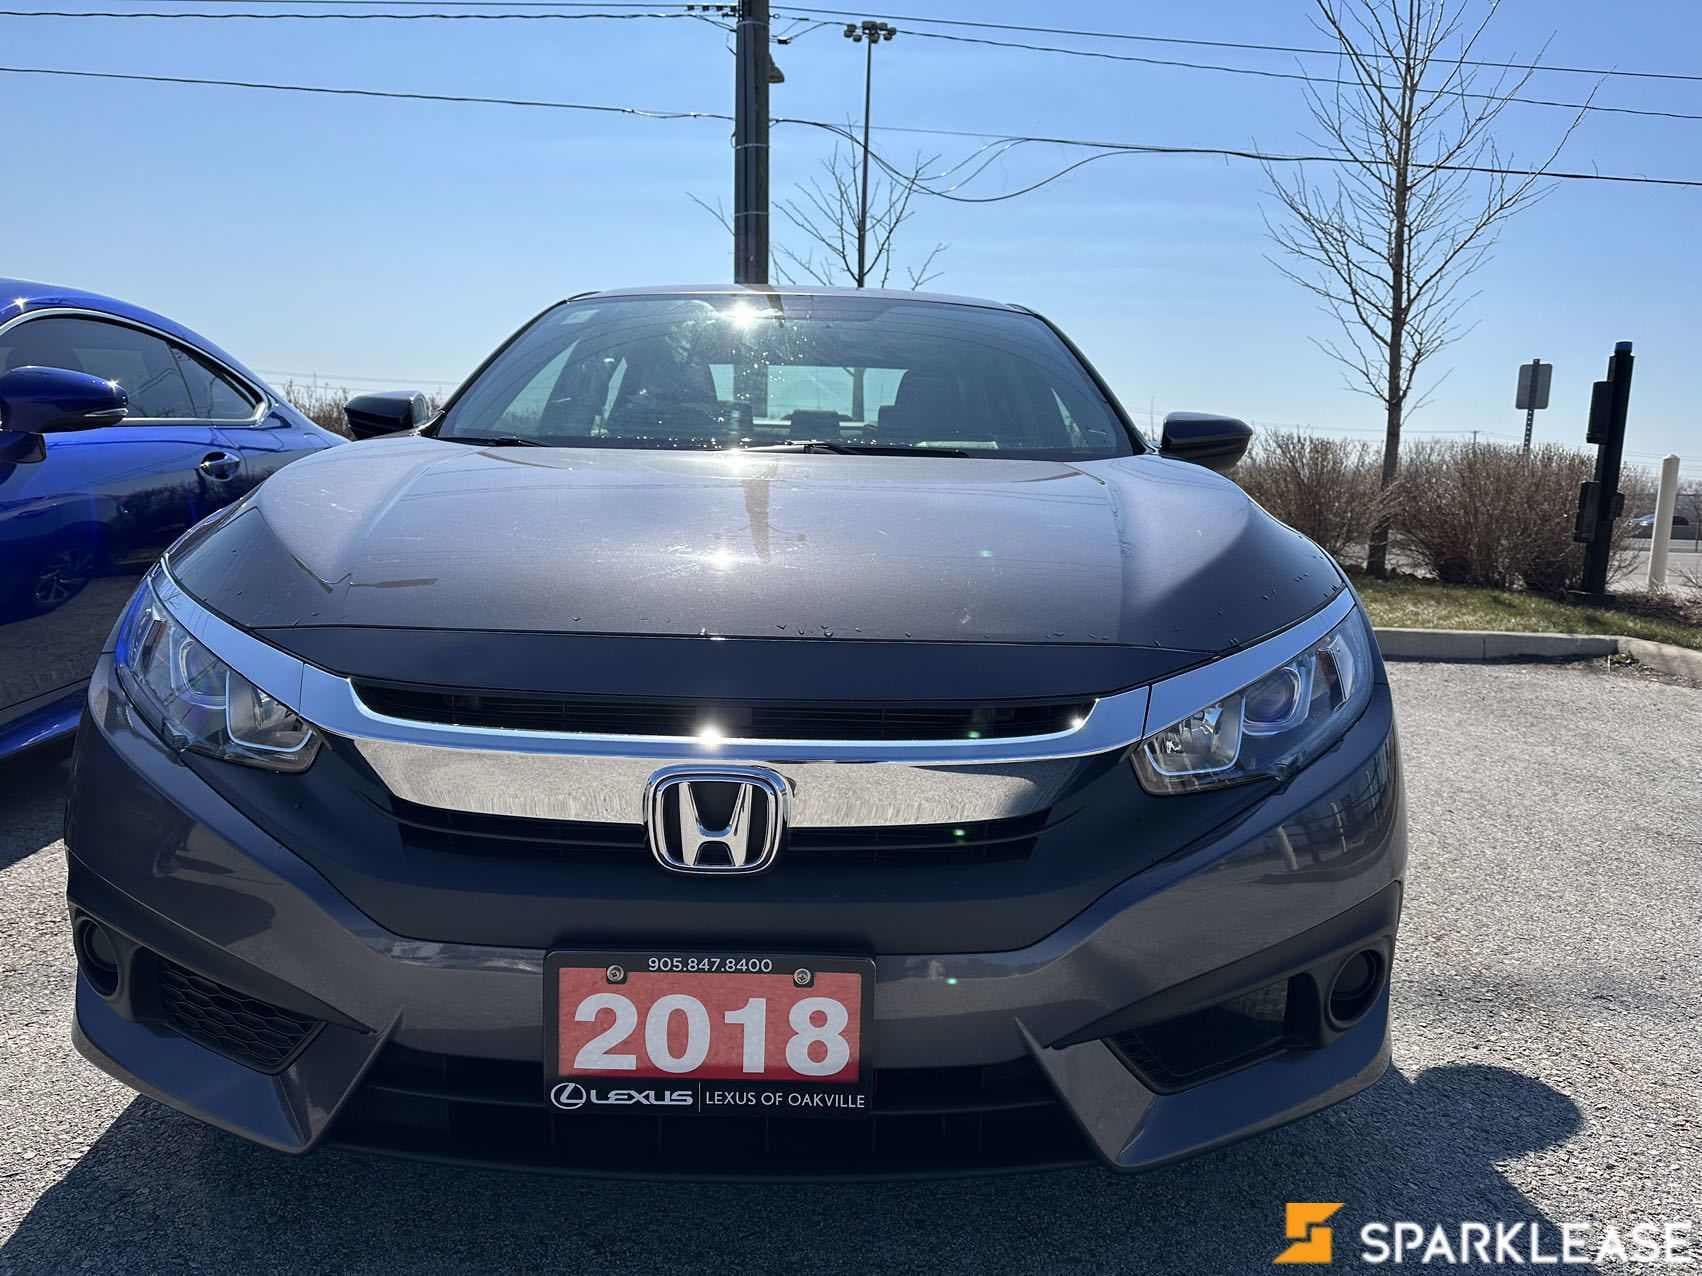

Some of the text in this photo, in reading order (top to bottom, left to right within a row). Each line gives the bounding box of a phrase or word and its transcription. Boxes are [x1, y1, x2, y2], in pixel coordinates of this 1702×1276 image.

[648, 957, 773, 973] 905.847.8400
[573, 992, 850, 1077] 2018
[590, 1089, 694, 1105] LEXUS
[706, 1091, 865, 1109] LEXUS OF OAKVILLE
